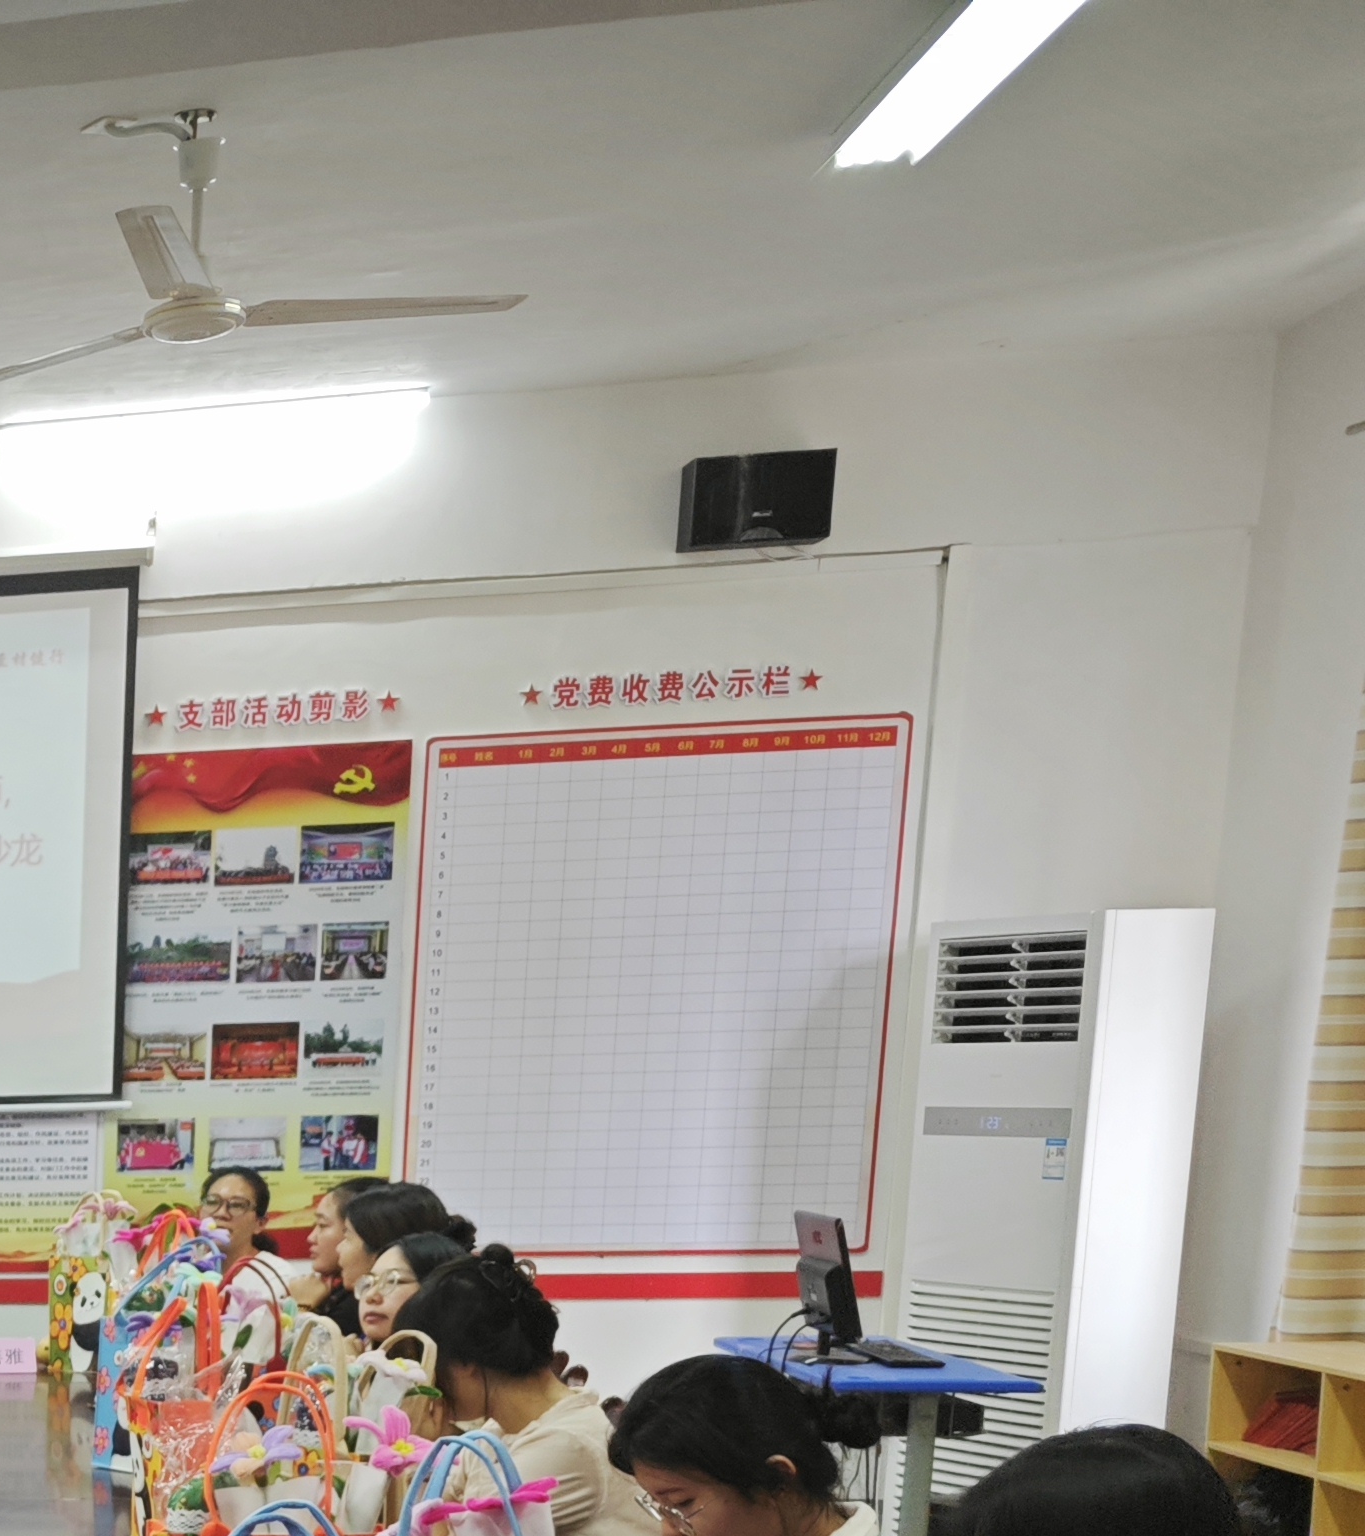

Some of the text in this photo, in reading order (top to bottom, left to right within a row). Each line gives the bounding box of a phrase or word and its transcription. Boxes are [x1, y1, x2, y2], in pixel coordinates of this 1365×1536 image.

[552, 664, 792, 709] 党费收费公示栏
[177, 690, 371, 730] 支部活动剪影
[474, 751, 494, 763] 姓名
[518, 748, 533, 759] 1月
[549, 747, 565, 758] 2月
[581, 744, 597, 756] 3月
[611, 743, 627, 755] 4月
[644, 742, 661, 753] 5月
[678, 740, 694, 751] 6月
[709, 738, 724, 750] 7月
[742, 737, 759, 748] 8月
[774, 735, 790, 747] 9月
[804, 734, 826, 745] 10月
[837, 732, 859, 744] 11月
[869, 731, 891, 742] 12月
[432, 949, 442, 957] 10
[431, 969, 441, 977] 11
[430, 988, 440, 996] 12
[429, 1007, 439, 1015] 13
[428, 1026, 438, 1034] 14
[427, 1045, 437, 1054] 15
[425, 1064, 435, 1073] 16
[424, 1083, 434, 1091] 17
[423, 1102, 433, 1110] 18
[422, 1121, 432, 1129] 19
[420, 1140, 432, 1148] 20
[420, 1159, 430, 1167] 21
